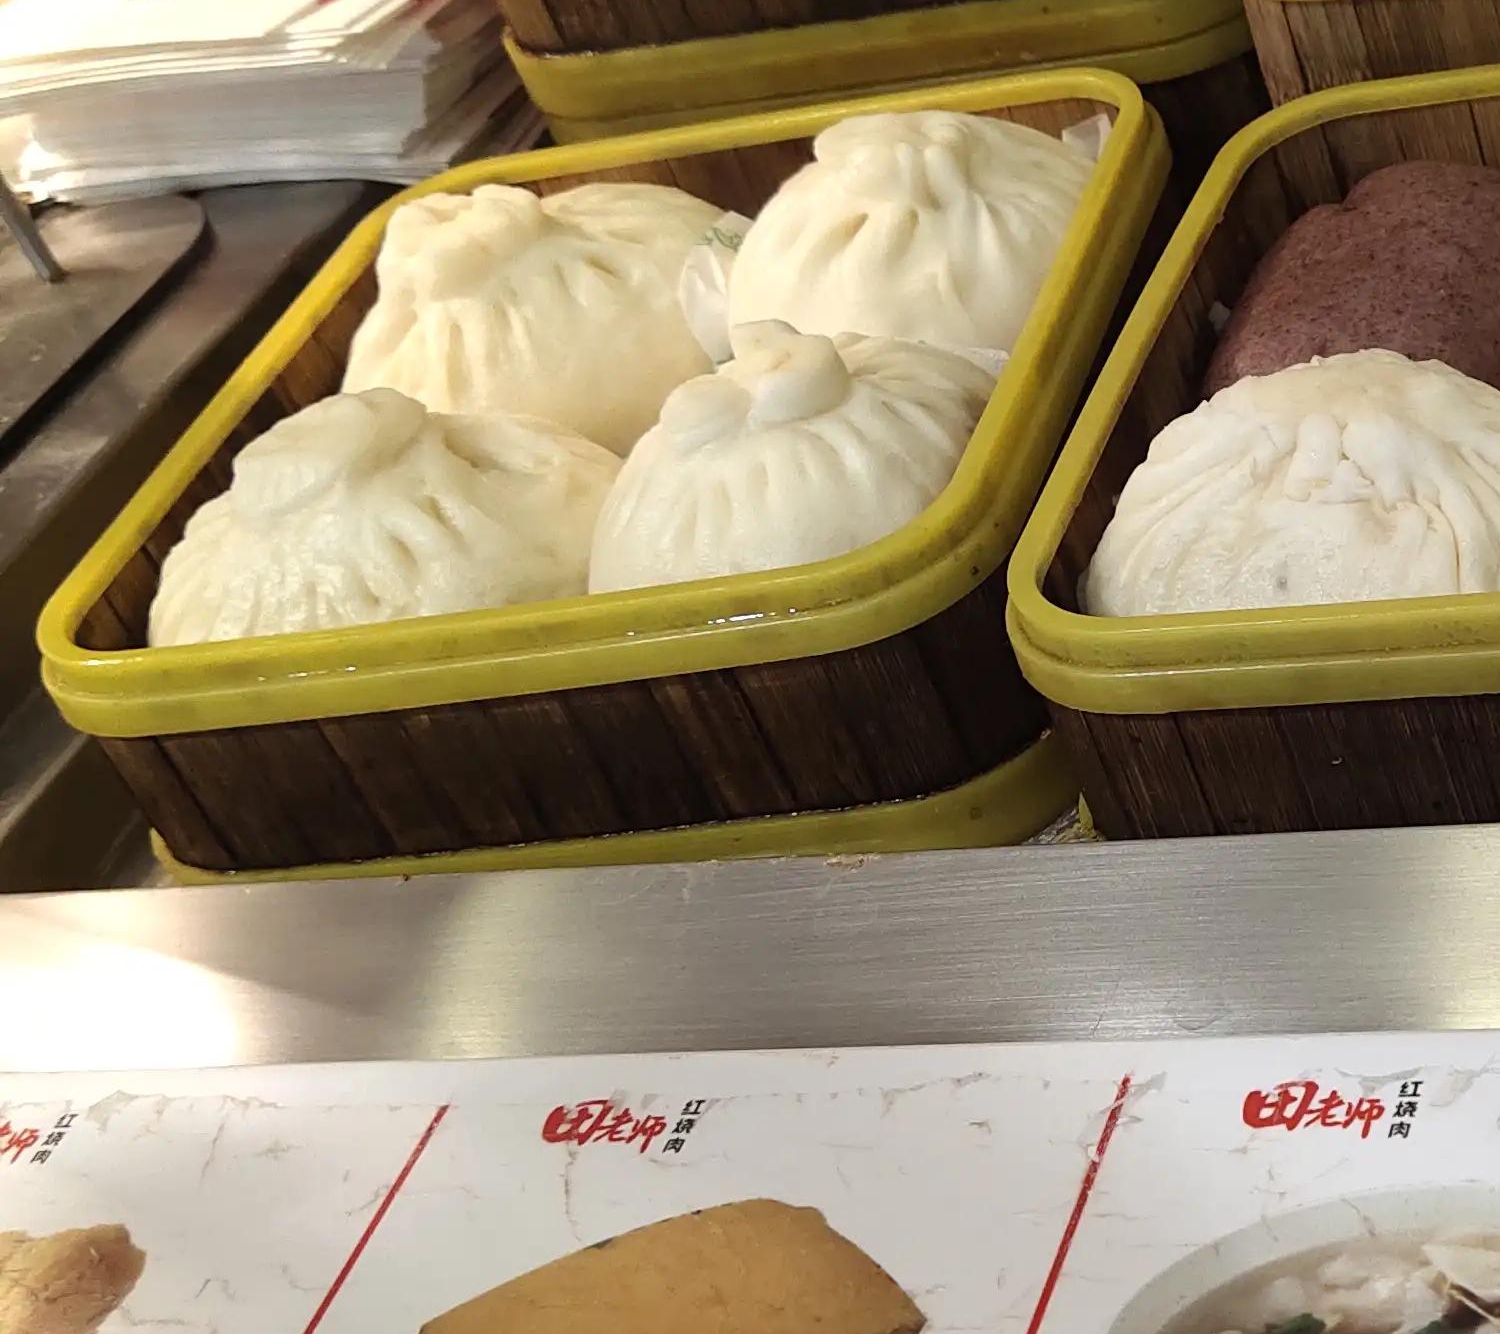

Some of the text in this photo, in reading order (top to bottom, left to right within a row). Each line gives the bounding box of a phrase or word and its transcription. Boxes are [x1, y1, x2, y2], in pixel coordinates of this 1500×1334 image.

[542, 1099, 667, 1154] 田老师
[662, 1099, 706, 1154] 红烧肉
[1242, 1080, 1385, 1139] 田老师
[1387, 1080, 1424, 1139] 红烧肉
[30, 1113, 79, 1164] 红烧肉
